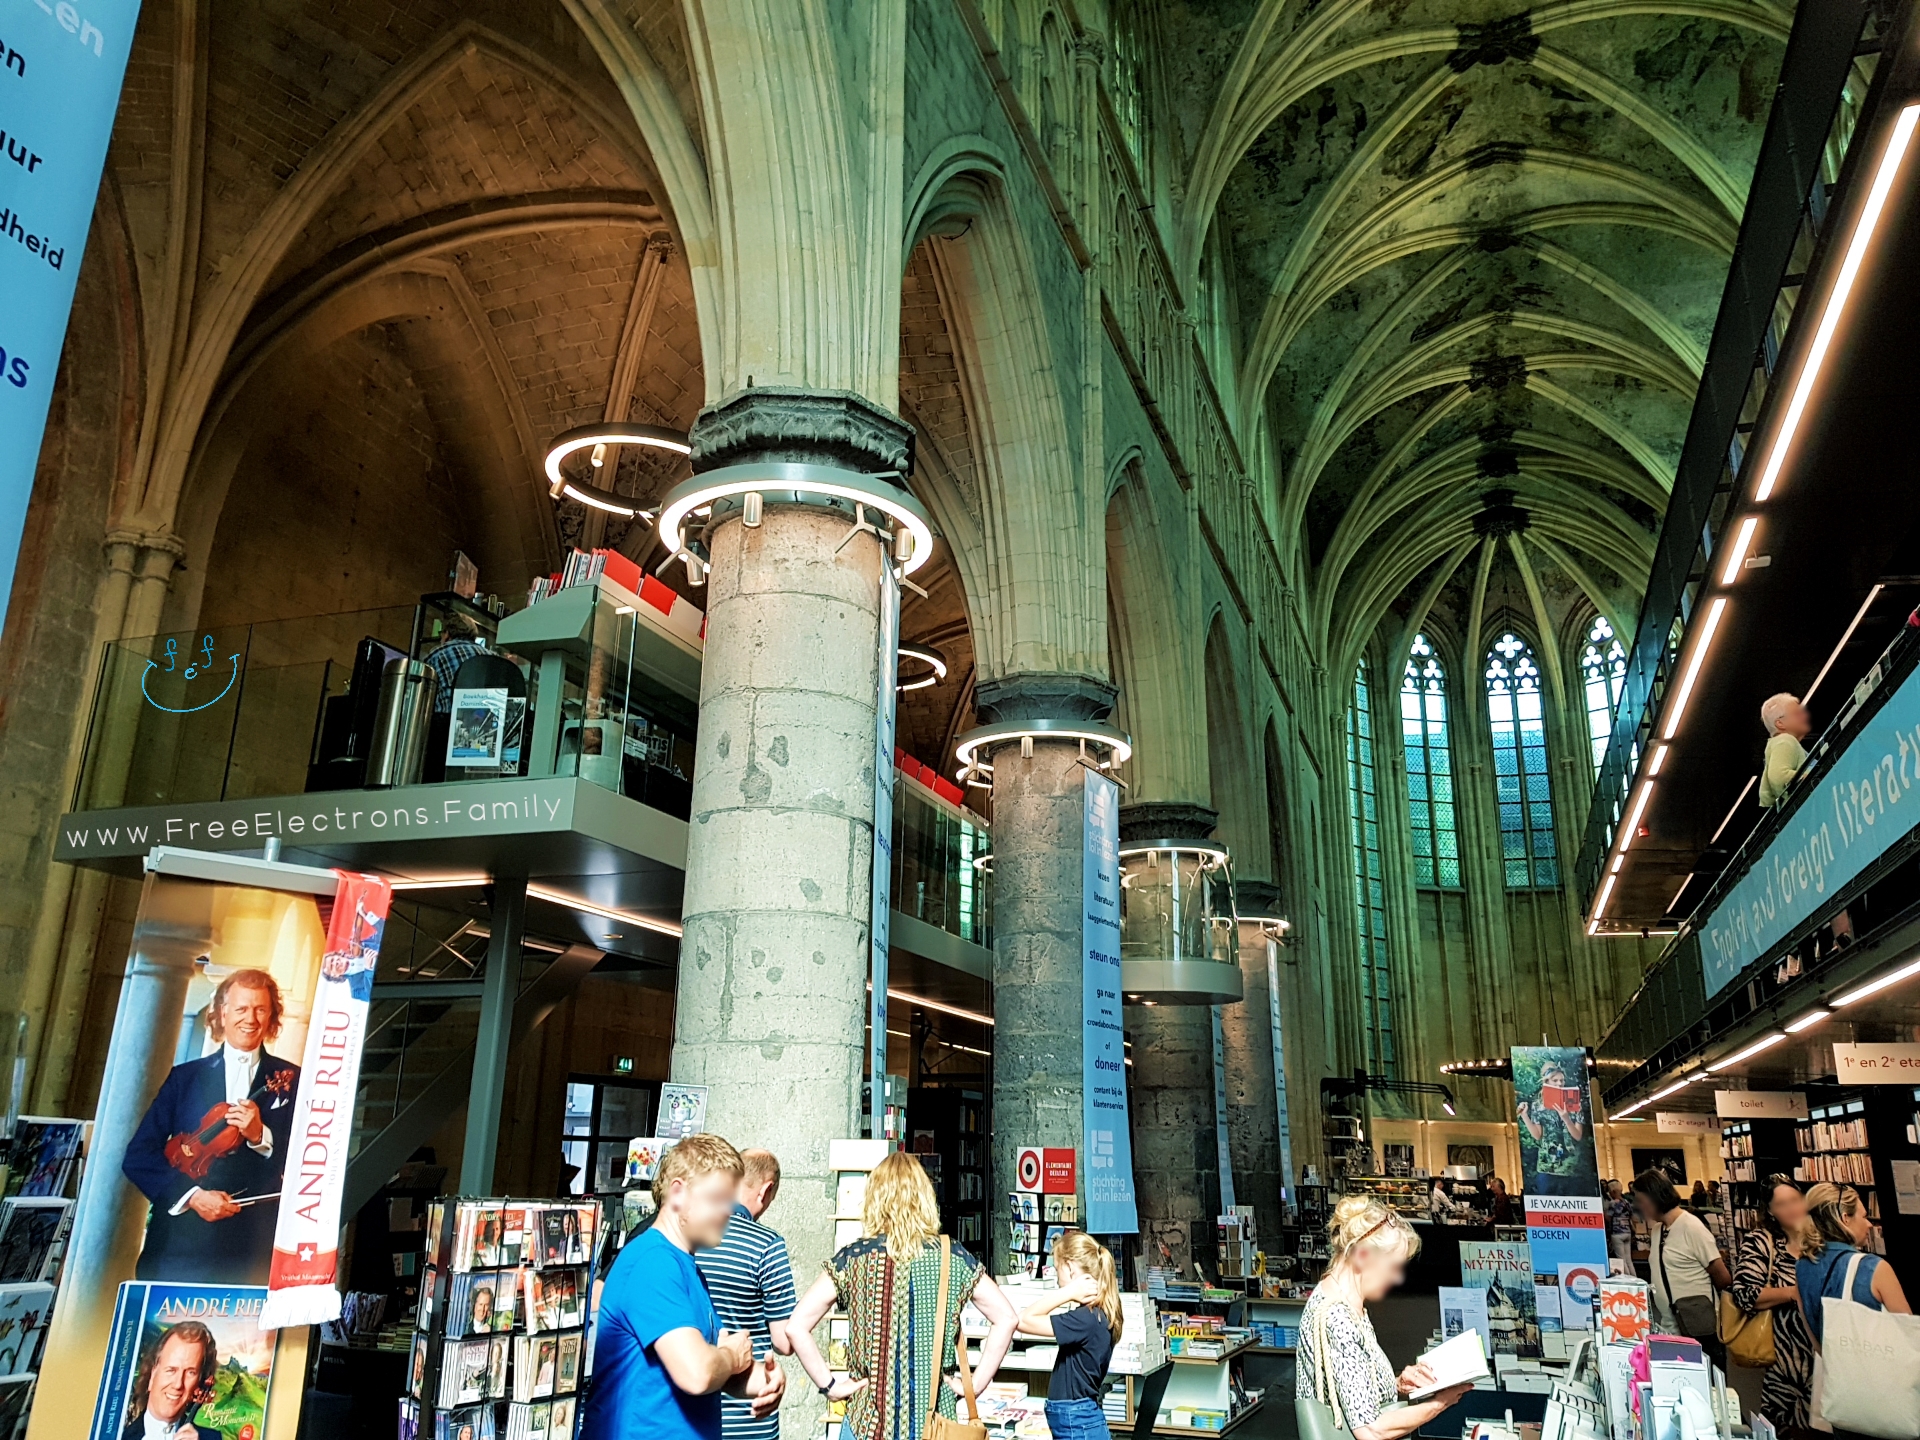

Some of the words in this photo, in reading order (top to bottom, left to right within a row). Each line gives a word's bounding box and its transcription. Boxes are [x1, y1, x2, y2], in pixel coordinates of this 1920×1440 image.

[1774, 822, 1835, 909] foreign
[1089, 949, 1109, 964] steun
[1096, 988, 1104, 999] ga
[1104, 989, 1116, 1000] naar
[314, 1009, 351, 1087] RIEU
[1104, 1041, 1111, 1051] of
[1094, 1055, 1121, 1072] doneer
[1860, 1059, 1877, 1068] en
[1093, 1086, 1111, 1095] contant
[1117, 1087, 1123, 1097] de
[1740, 1099, 1764, 1109] toilet
[1686, 1120, 1706, 1128] etage
[294, 1098, 337, 1224] ANDRÉ
[1092, 1173, 1126, 1190] stichting
[1092, 1188, 1101, 1202] lol
[1102, 1189, 1110, 1202] in
[1110, 1188, 1132, 1203] lezen
[1530, 1199, 1541, 1209] JE
[1540, 1199, 1588, 1211] VAKANTIE
[1542, 1214, 1577, 1225] BEGINT
[1577, 1215, 1598, 1226] MET
[1531, 1229, 1570, 1241] BOEKEN
[1478, 1249, 1514, 1260] LARS
[1464, 1259, 1530, 1272] MYTTING
[153, 1292, 231, 1318] ANDRÉ
[234, 1298, 267, 1318] RIE
[114, 1358, 127, 1392] ROMANTIC
[122, 1326, 133, 1358] MOMENTS
